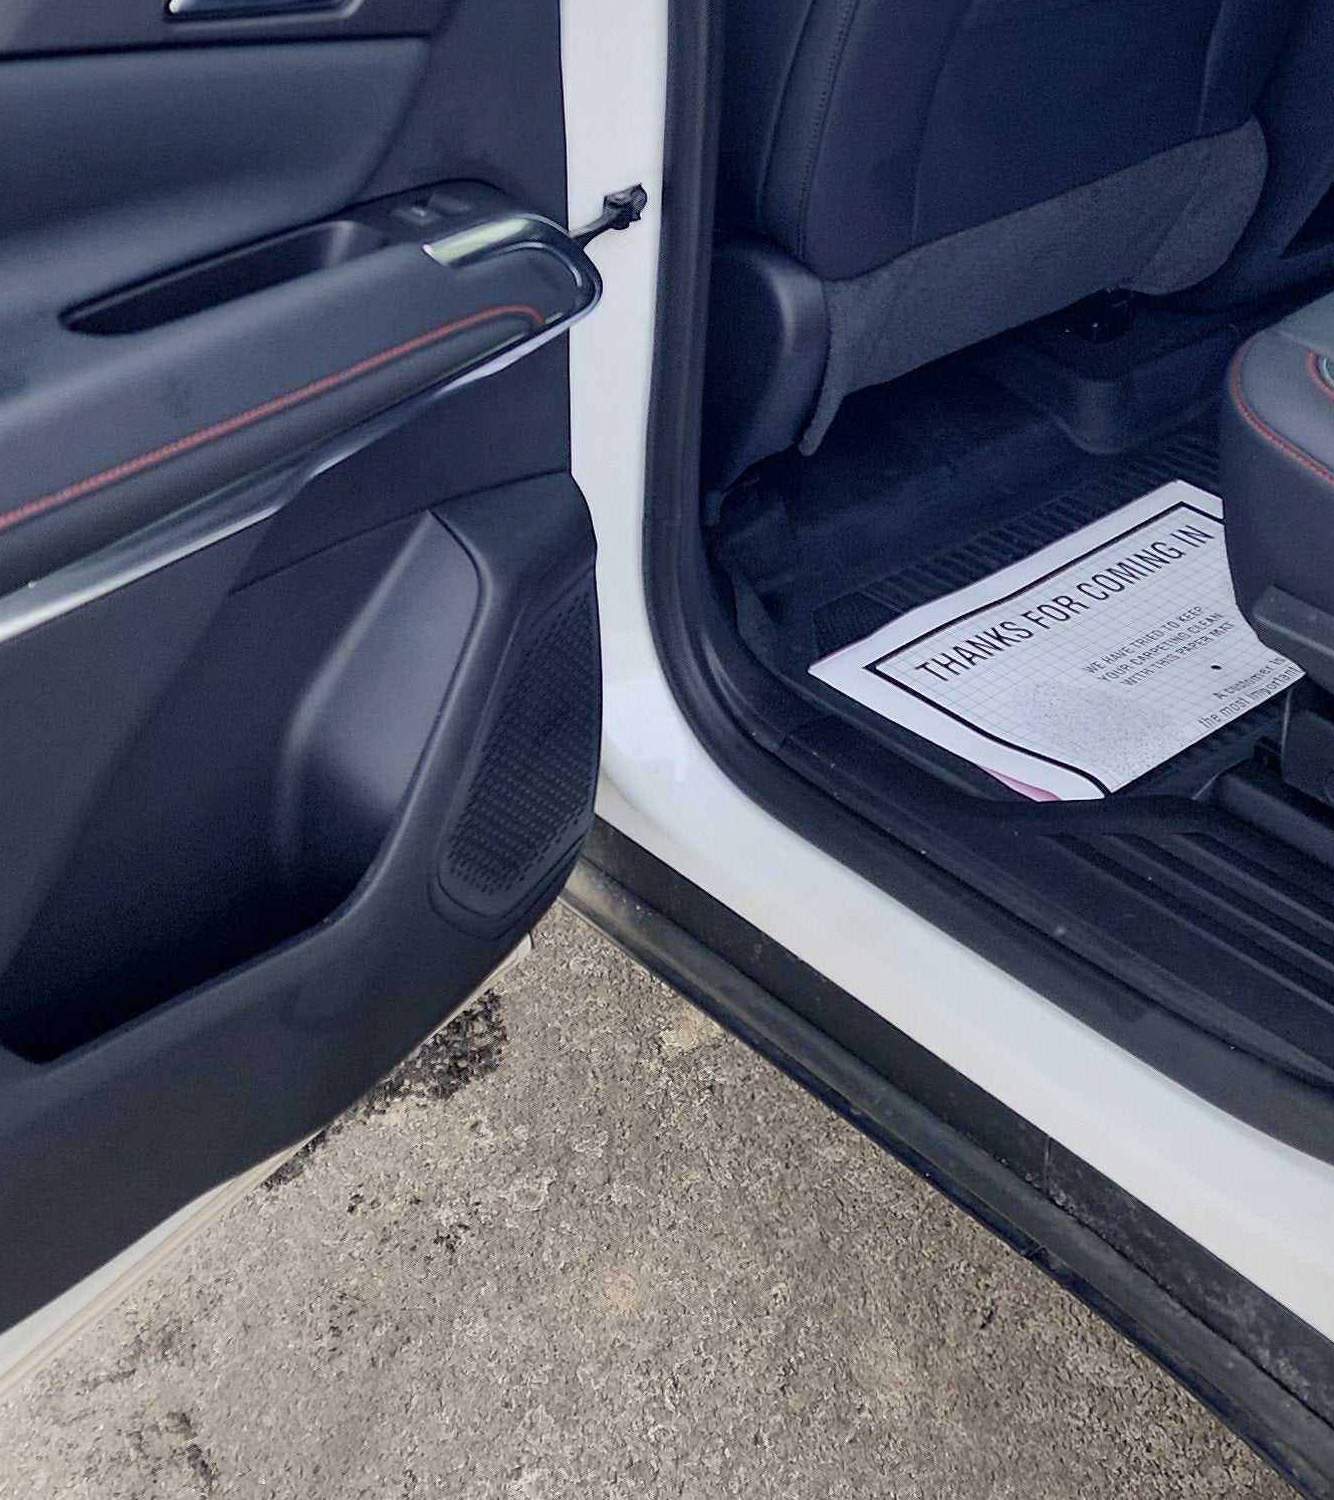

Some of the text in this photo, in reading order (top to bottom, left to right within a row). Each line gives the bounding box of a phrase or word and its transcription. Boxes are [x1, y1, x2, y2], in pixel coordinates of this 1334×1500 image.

[914, 524, 1216, 682] THANKS FOR COMING IN
[1082, 605, 1202, 673] WE HAVE TRIED TO KEEP
[1097, 612, 1225, 683] YOUR CARPETING CLEAN
[1120, 621, 1235, 686] WITH THIS PAPER MAT
[1197, 665, 1301, 729] the most important
[1212, 691, 1228, 700] A
[1223, 665, 1274, 695] customer
